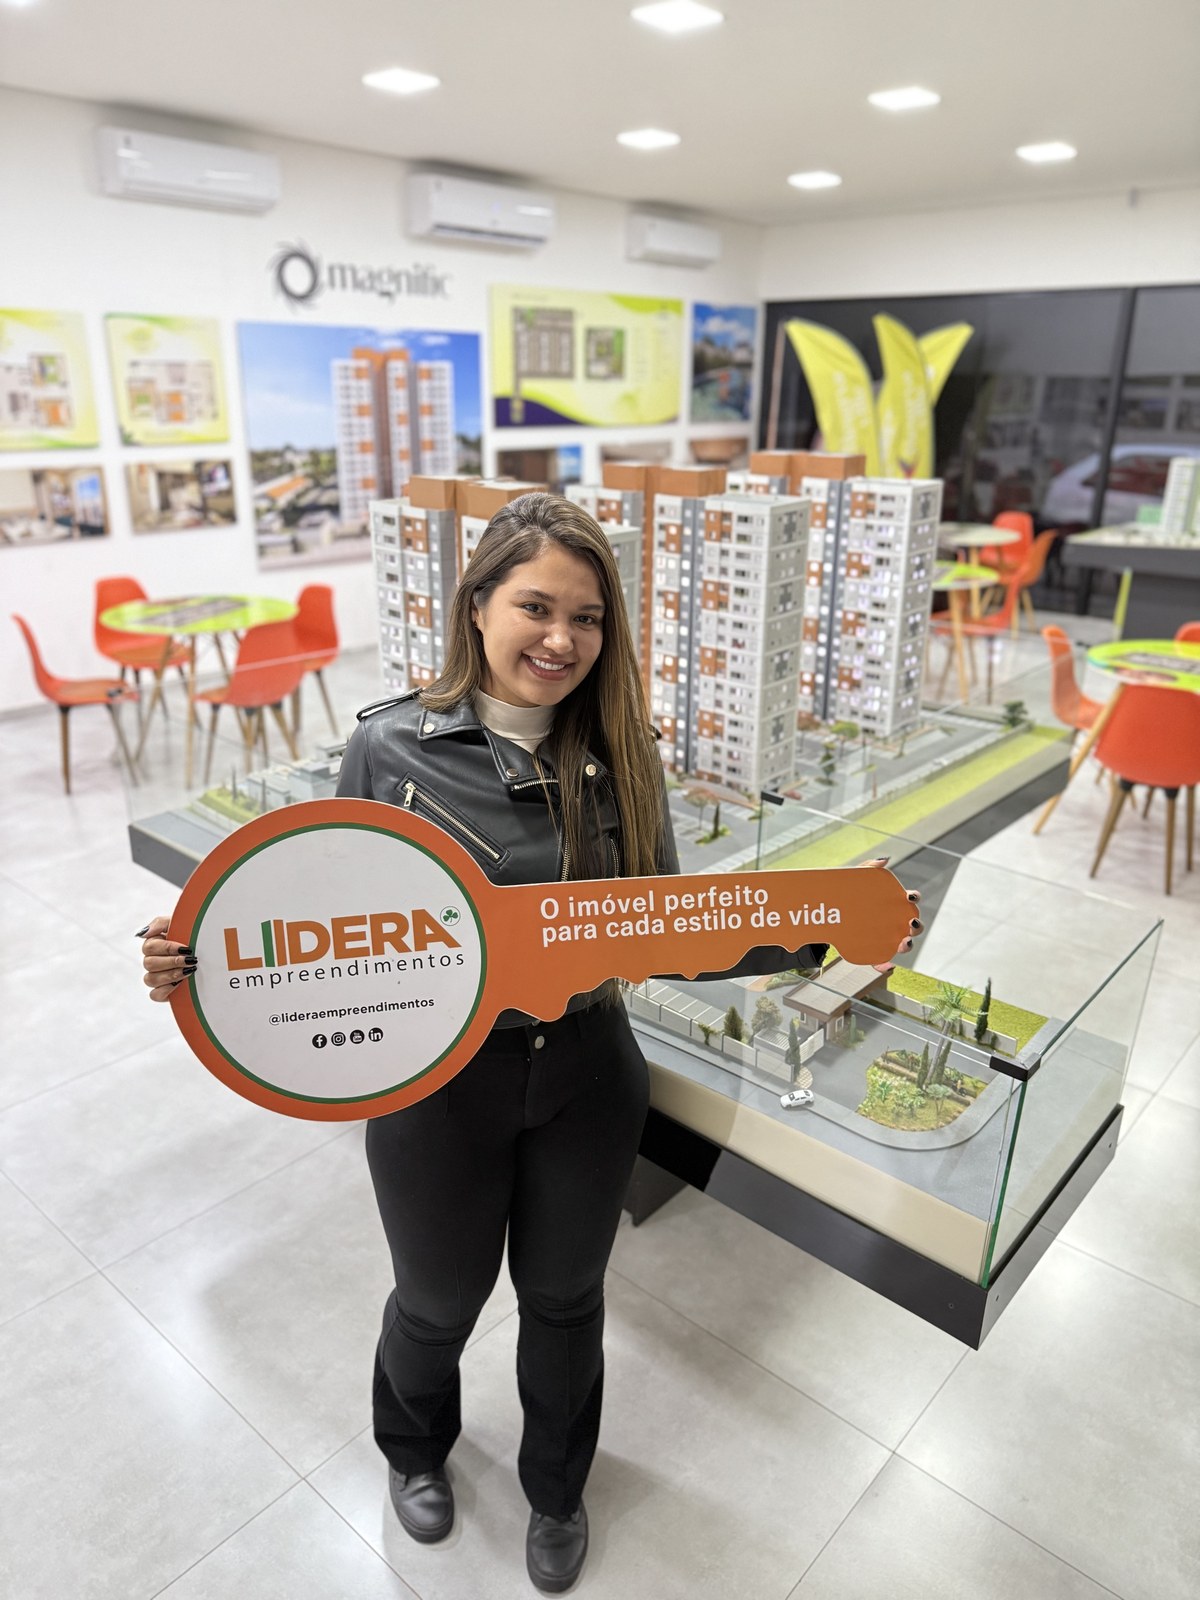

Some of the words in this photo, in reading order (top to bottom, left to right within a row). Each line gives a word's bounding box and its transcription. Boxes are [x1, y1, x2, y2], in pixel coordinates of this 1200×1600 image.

[540, 897, 559, 920] O
[568, 890, 655, 918] imóvel
[664, 884, 769, 915] perfeito
[542, 922, 598, 948] para
[605, 913, 665, 938] cada
[673, 908, 742, 933] estilo
[750, 906, 781, 928] de
[788, 902, 841, 926] vida
[228, 953, 465, 989] empreendimentos
[268, 998, 435, 1026] @lideraempreendimentos
